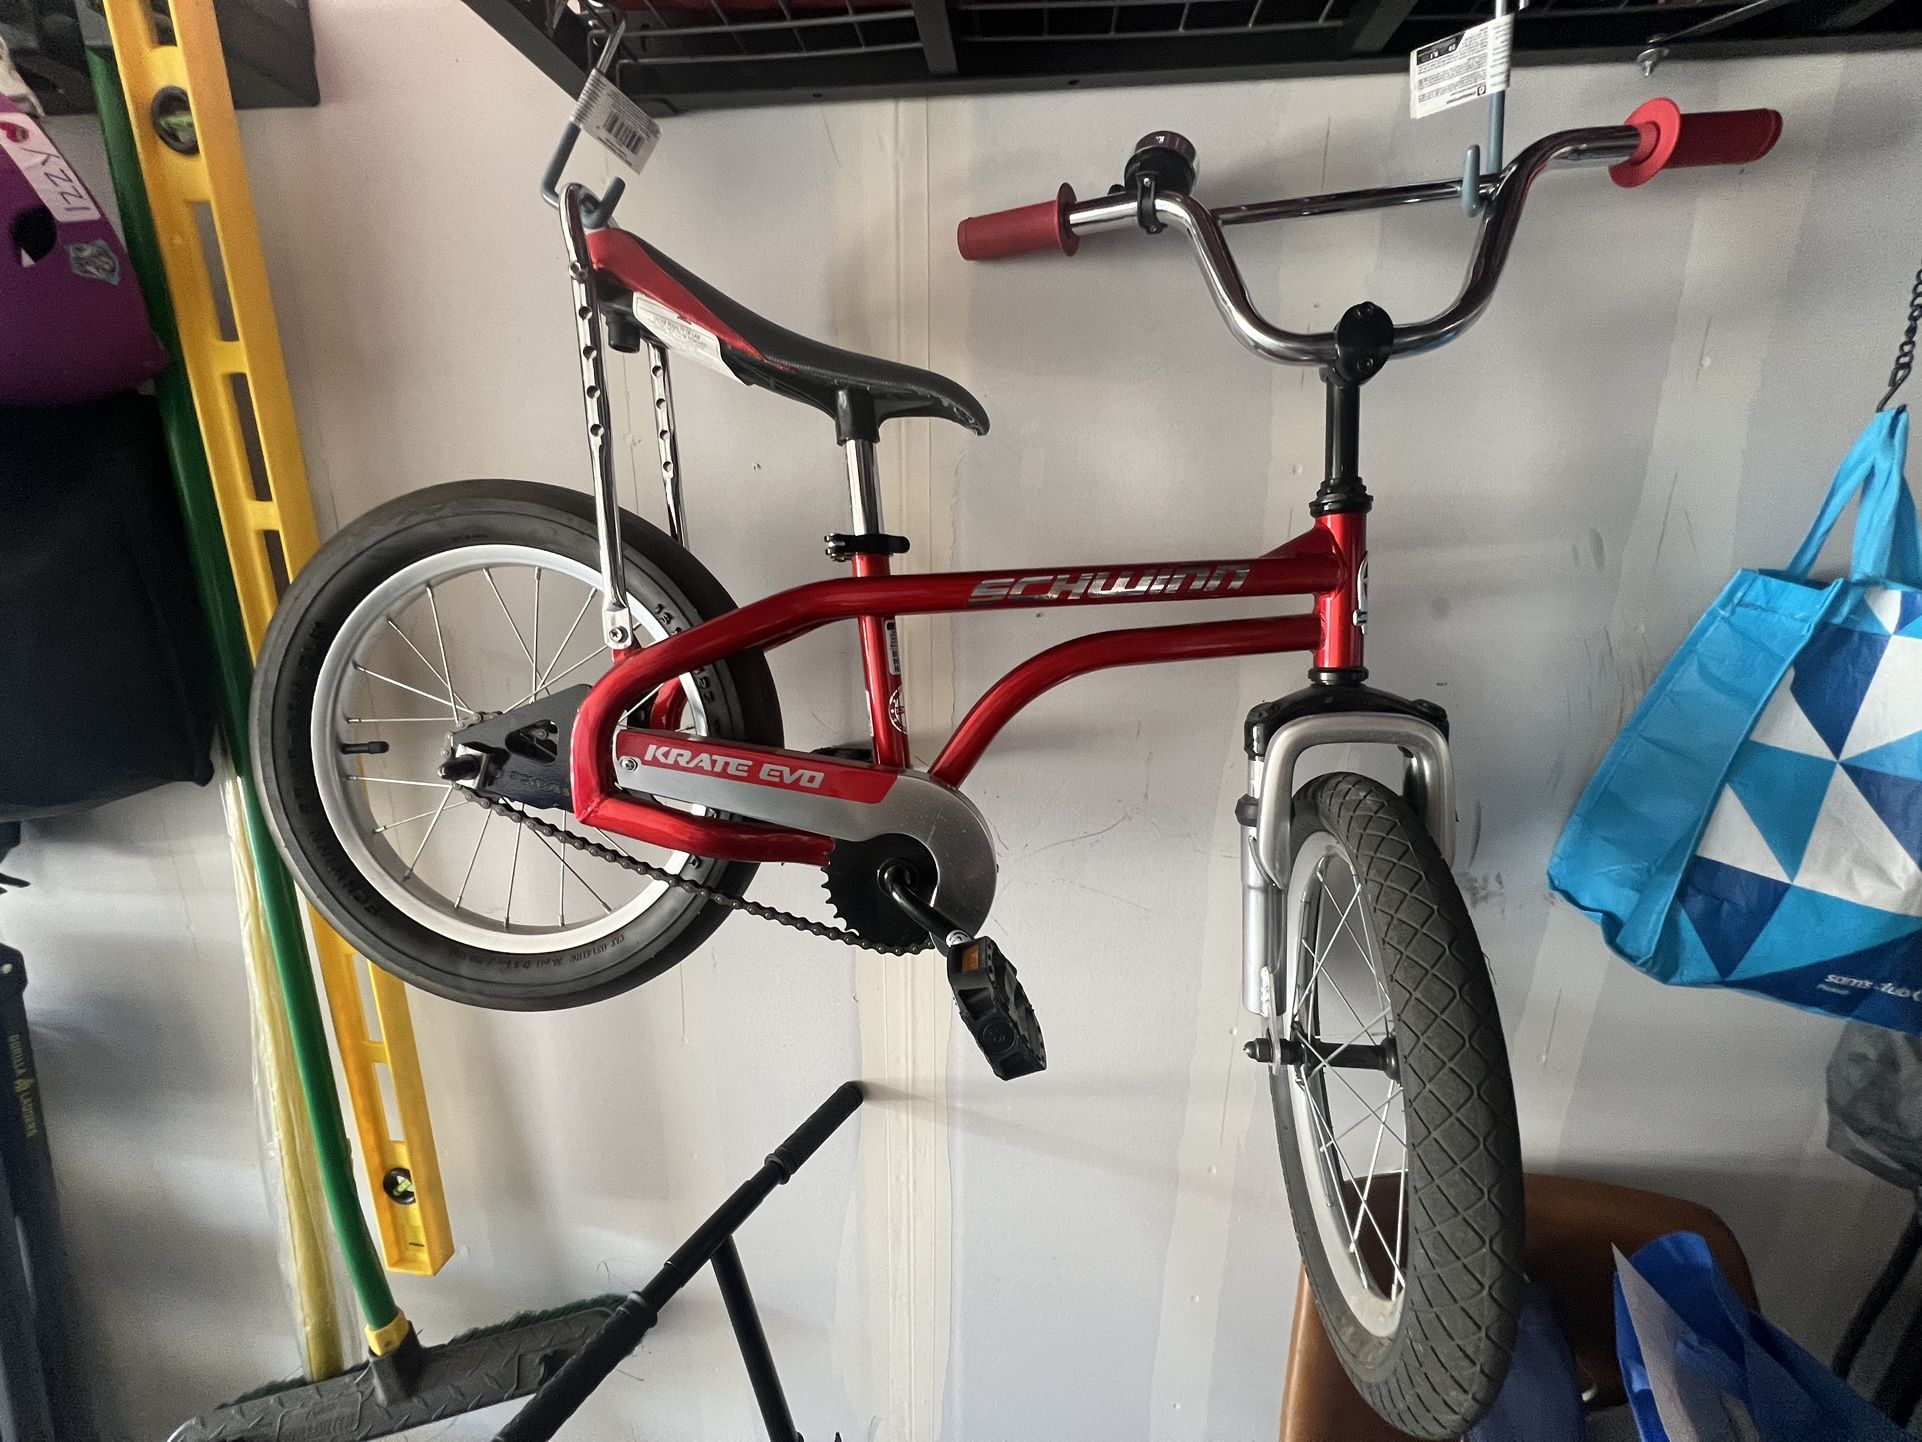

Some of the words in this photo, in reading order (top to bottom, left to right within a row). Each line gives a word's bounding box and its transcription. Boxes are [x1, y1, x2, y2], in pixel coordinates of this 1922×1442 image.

[19, 146, 92, 211] IZZY
[644, 744, 753, 777] KRATE
[758, 763, 825, 789] EVO
